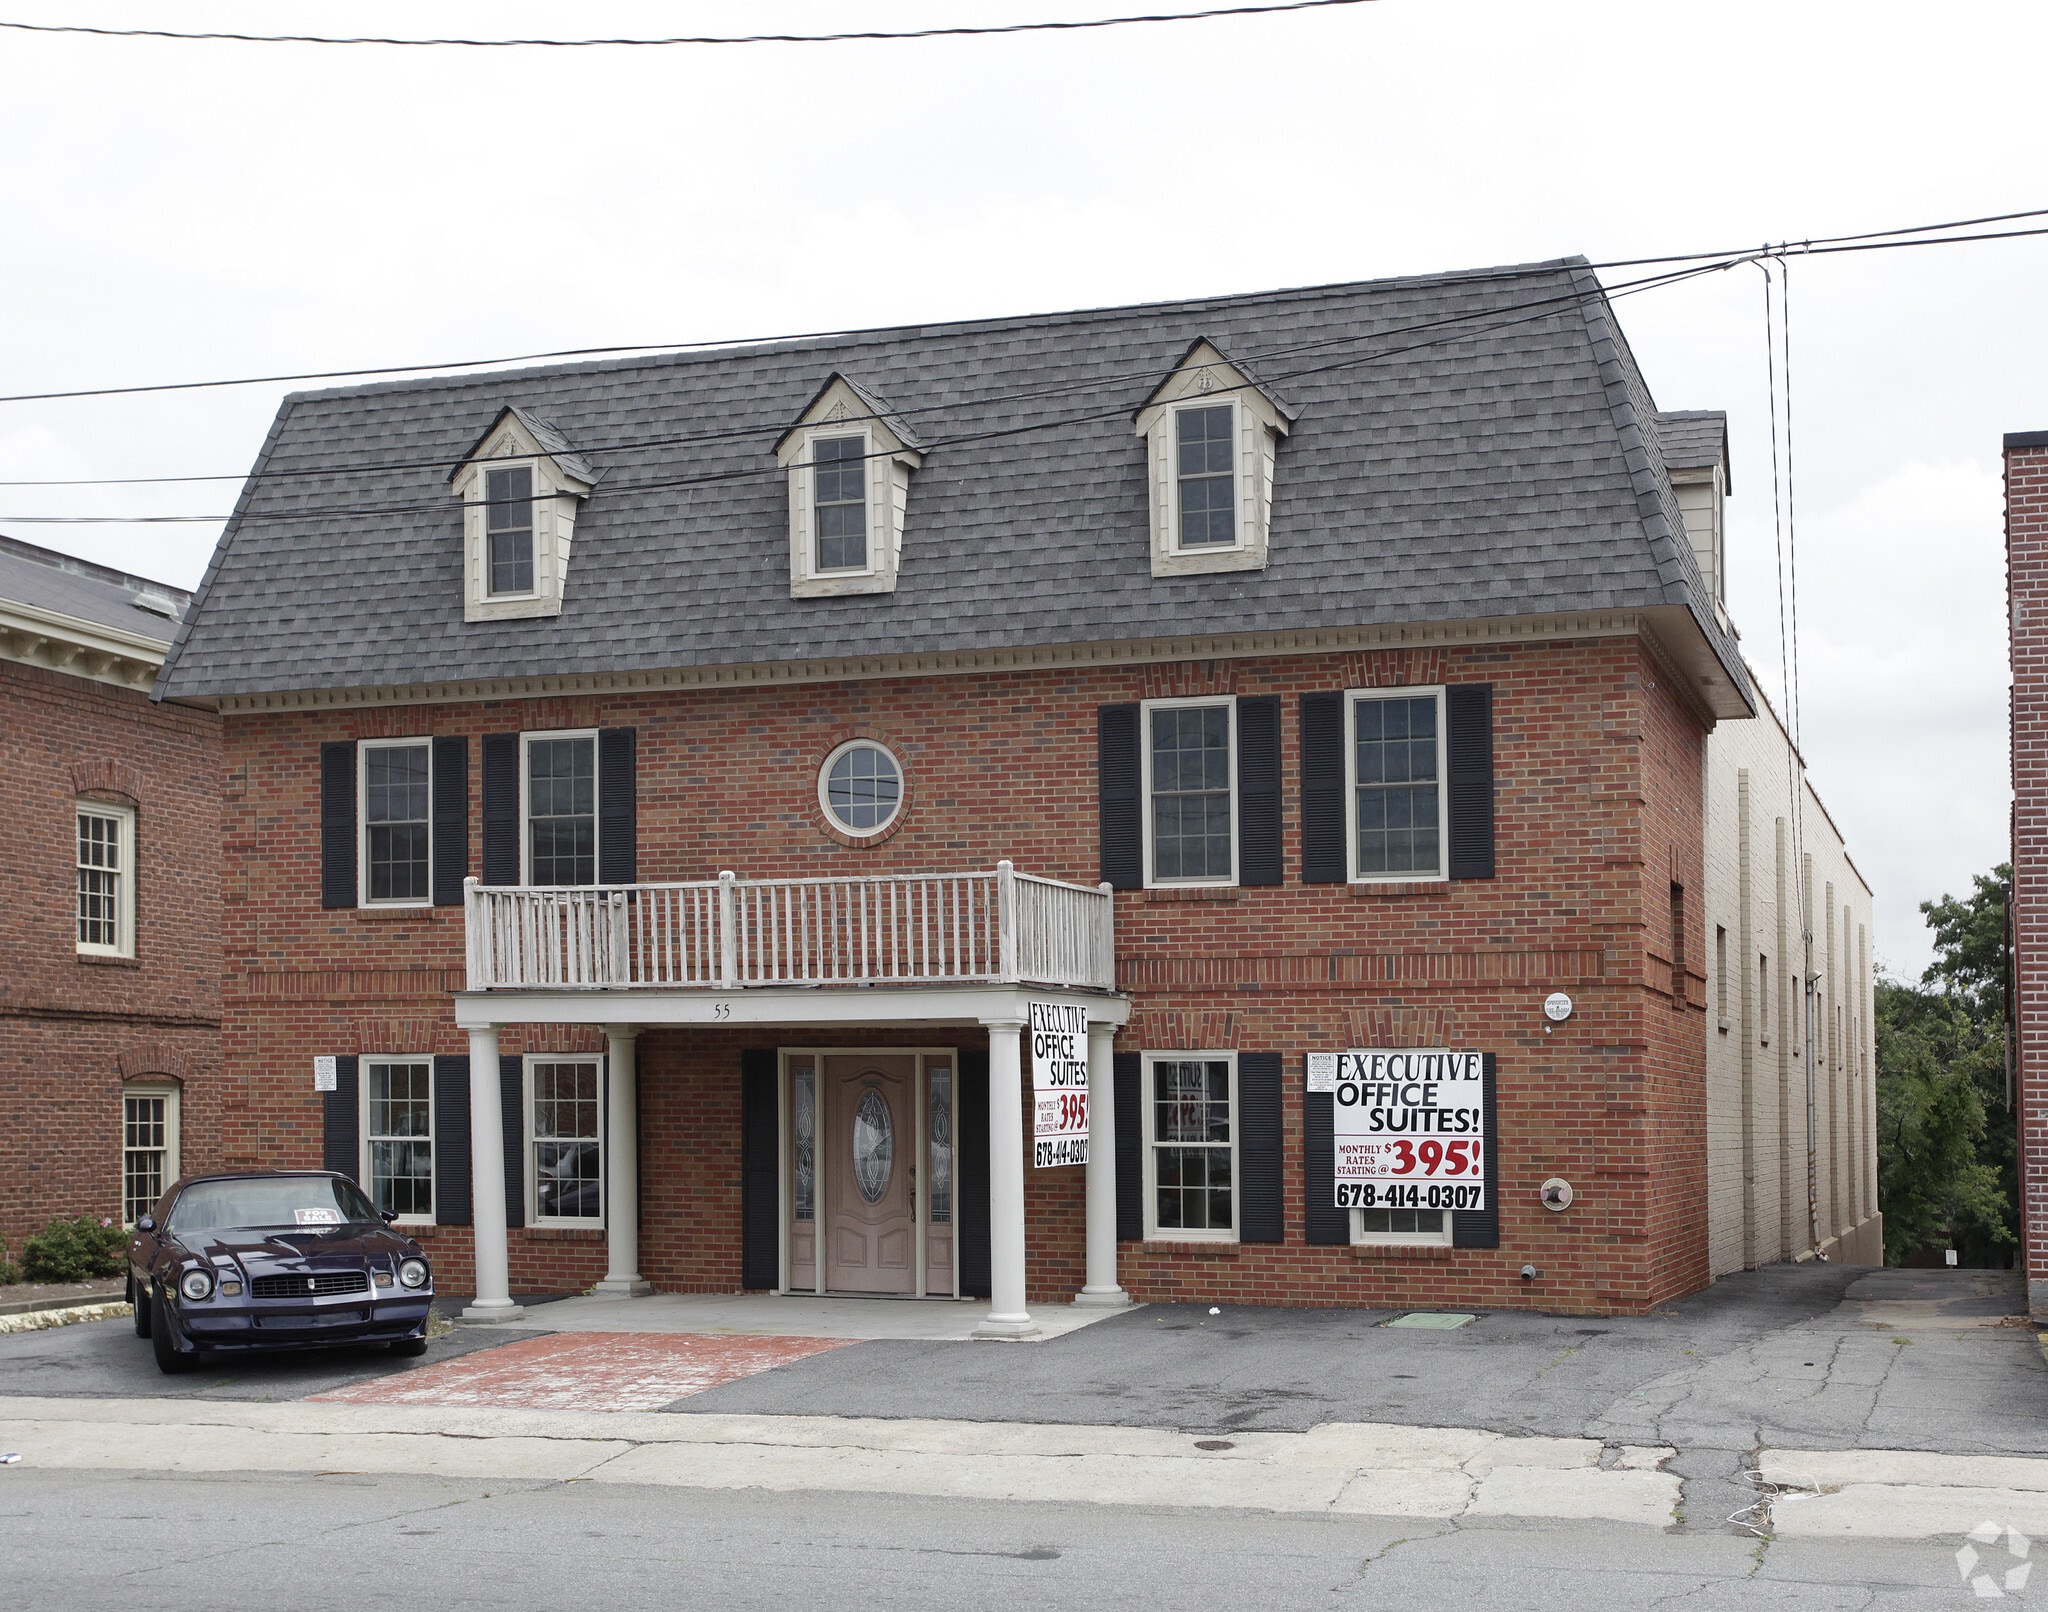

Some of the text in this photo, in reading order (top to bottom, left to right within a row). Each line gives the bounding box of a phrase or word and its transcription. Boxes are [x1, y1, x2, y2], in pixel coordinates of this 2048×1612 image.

[714, 1003, 730, 1019] 55
[1032, 1003, 1087, 1034] EXECUTIVE
[1035, 1034, 1074, 1059] OFFICE
[1335, 1054, 1481, 1081] EXECUTIVE
[1336, 1083, 1439, 1107] OFFICE
[1037, 1100, 1055, 1111] MONTHLY
[1041, 1112, 1054, 1122] RATES
[1369, 1108, 1480, 1132] SUITES!
[1036, 1122, 1053, 1133] STARTING
[1338, 1145, 1382, 1154] MONTHLY
[1346, 1156, 1376, 1165] RATES
[1337, 1164, 1389, 1175] STARTING @
[1336, 1184, 1481, 1208] 678-414-0307
